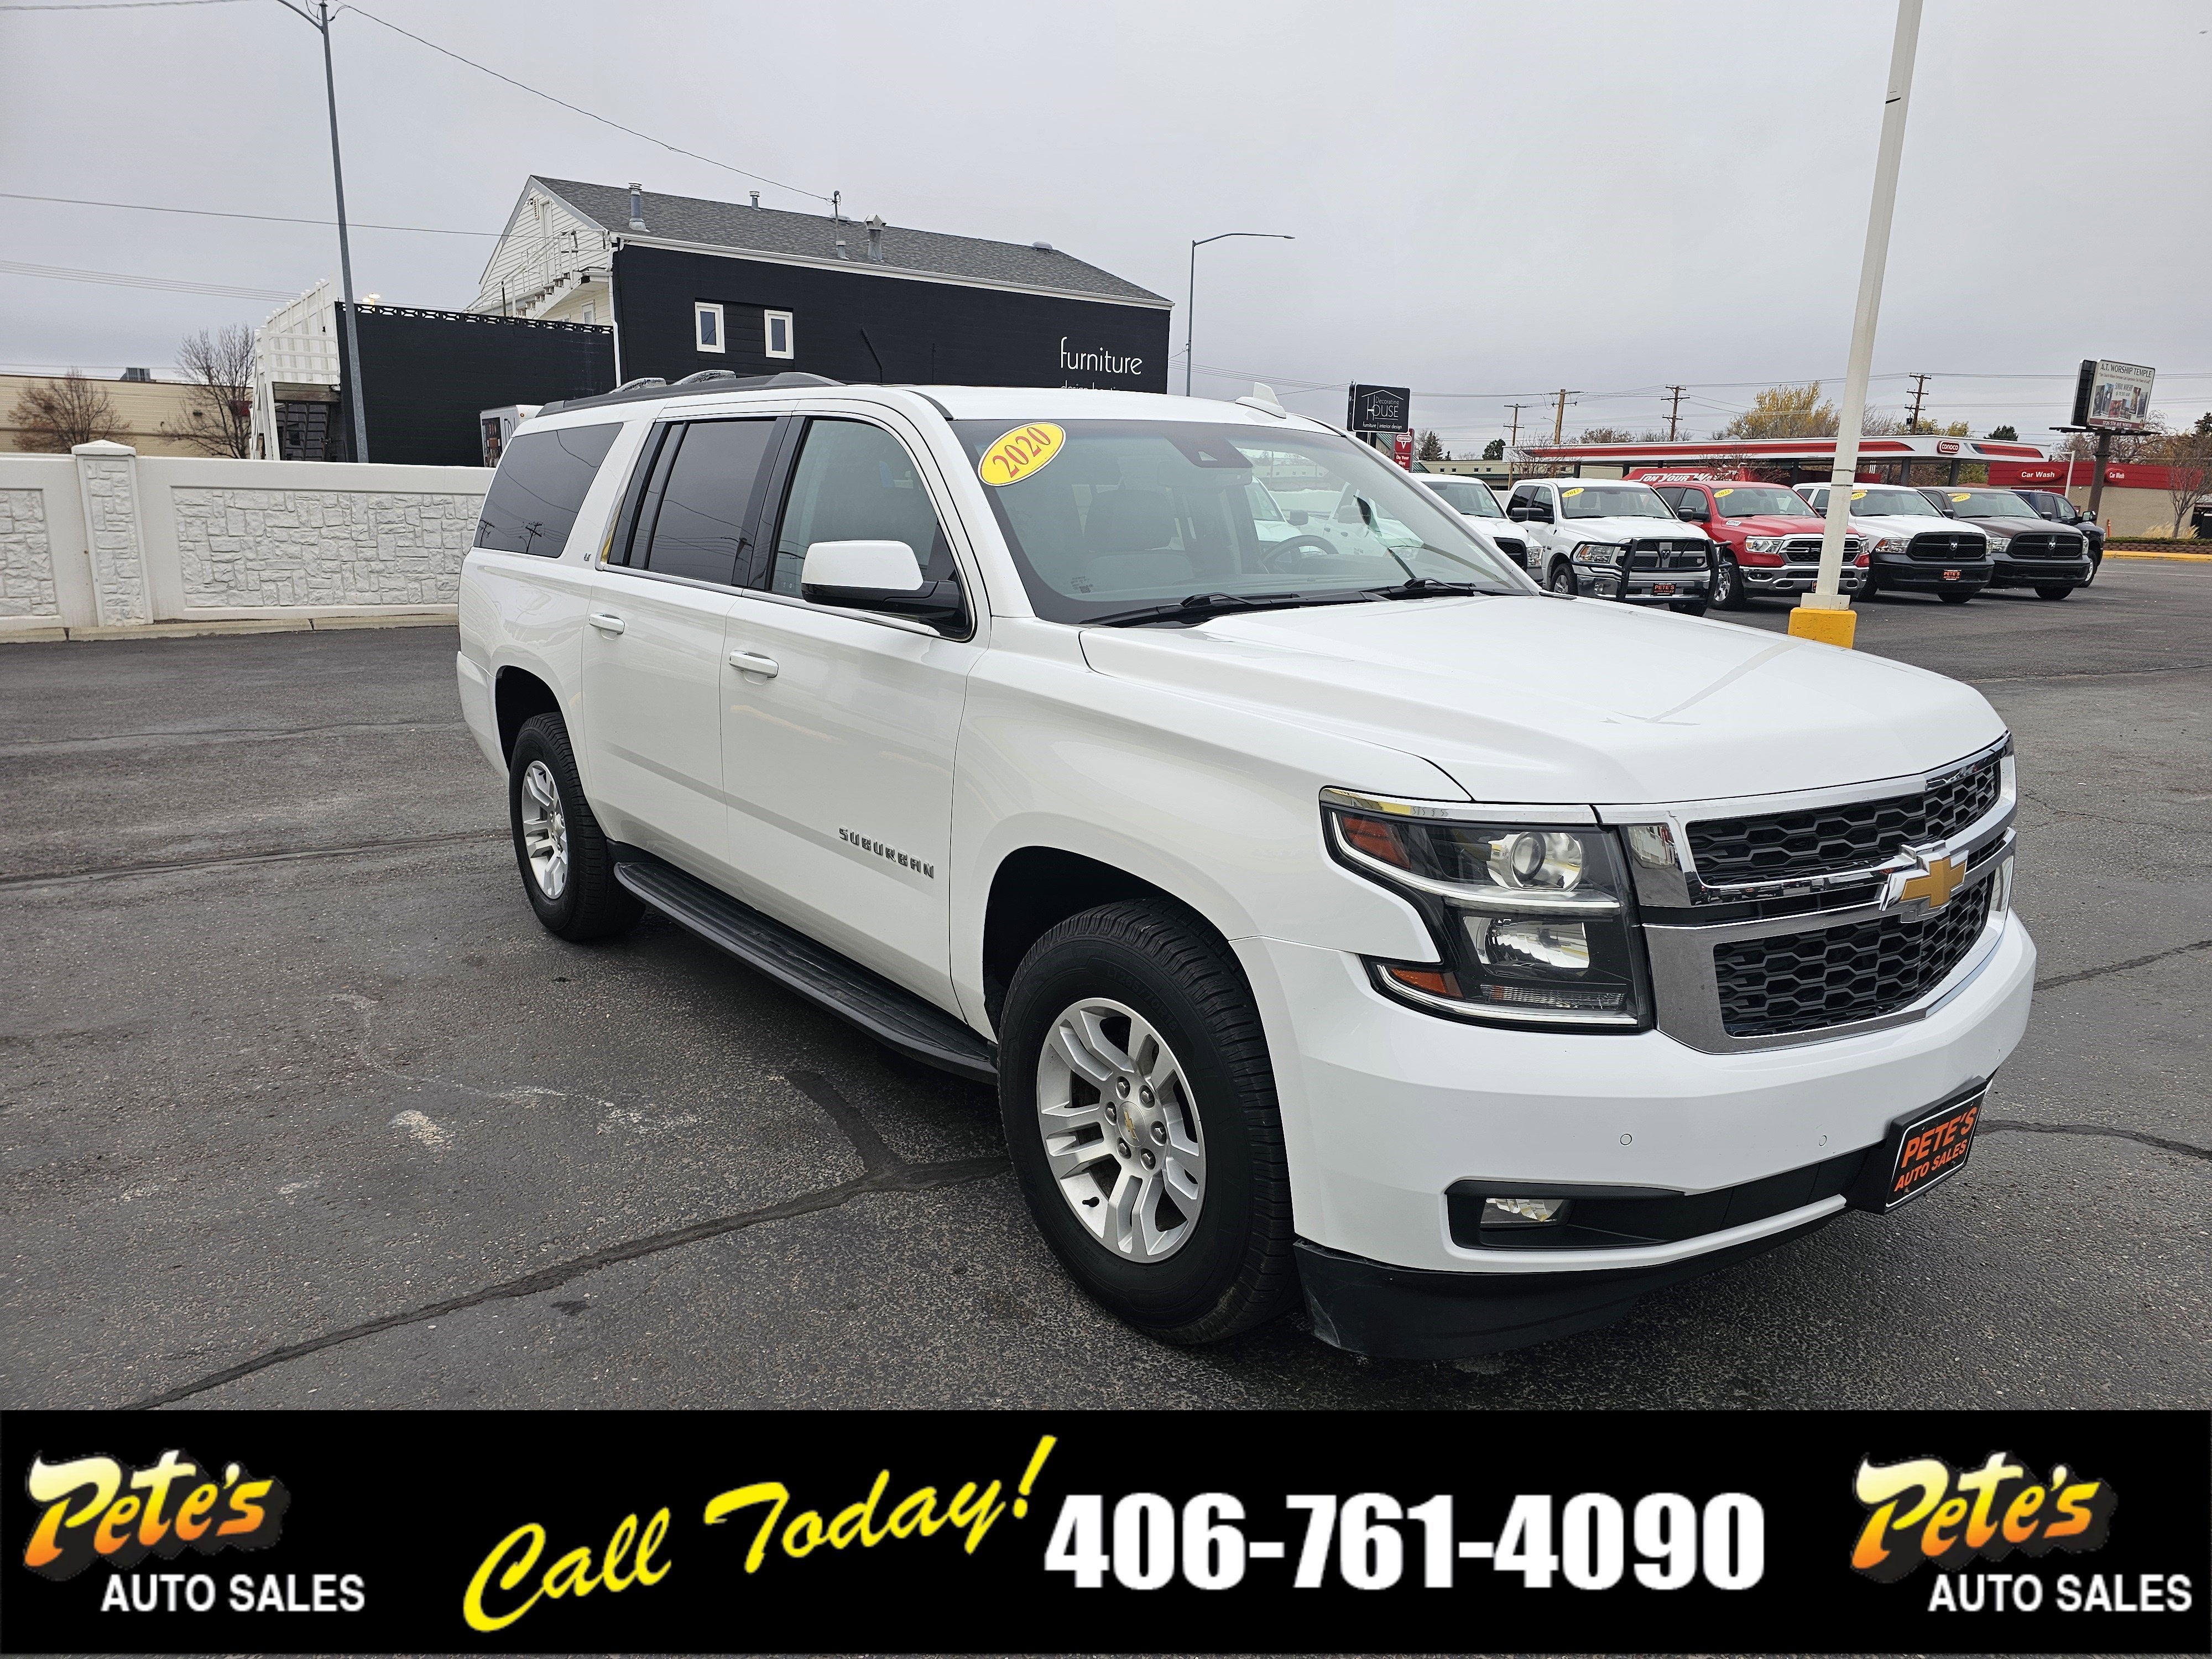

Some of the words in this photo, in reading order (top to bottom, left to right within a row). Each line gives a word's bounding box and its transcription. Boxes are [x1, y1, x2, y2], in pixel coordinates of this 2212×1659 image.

[1060, 336, 1142, 375] furniture
[2111, 364, 2133, 374] WORSHIP
[2134, 368, 2152, 378] TEMPLE
[1375, 396, 1400, 406] Decorating
[992, 427, 1051, 478] 2020
[839, 827, 934, 879] SUBURBAN
[1901, 1106, 1978, 1168] PETE'S
[1894, 1161, 1930, 1192] AUTO
[1931, 1139, 1968, 1171] SALES
